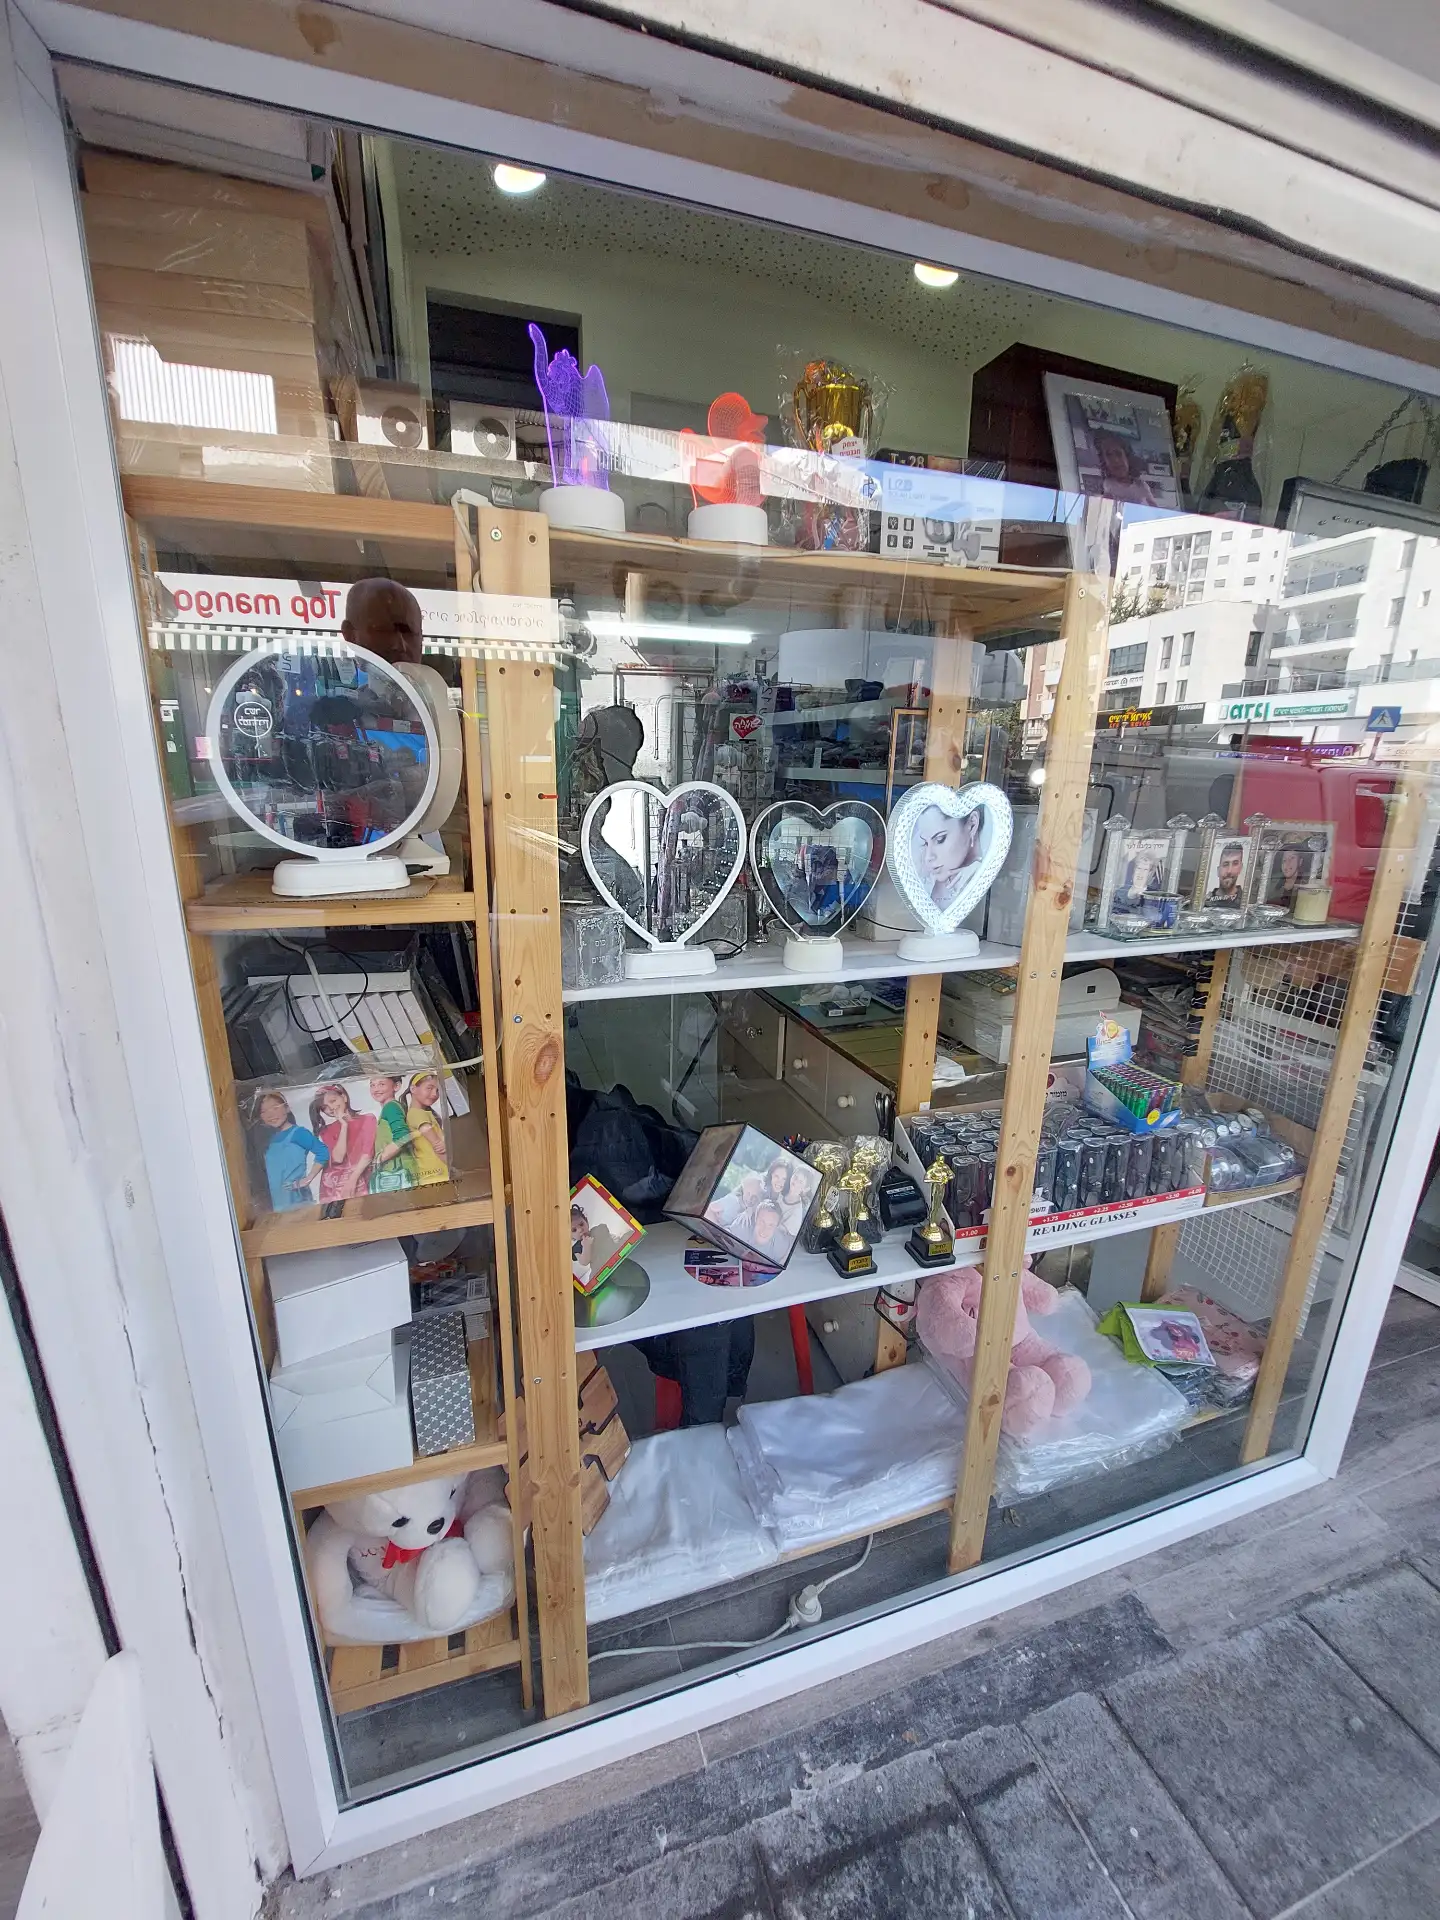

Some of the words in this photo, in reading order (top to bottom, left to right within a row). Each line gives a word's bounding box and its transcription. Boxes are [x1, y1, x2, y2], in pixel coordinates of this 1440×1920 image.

[1042, 1215, 1059, 1223] +1.75
[1068, 1210, 1084, 1218] +2.00
[1093, 1206, 1109, 1214] +2.25
[1118, 1201, 1134, 1209] +2.50
[960, 1229, 979, 1237] +1.00
[1032, 1218, 1088, 1237] READING
[1090, 1210, 1139, 1226] GLASSES
